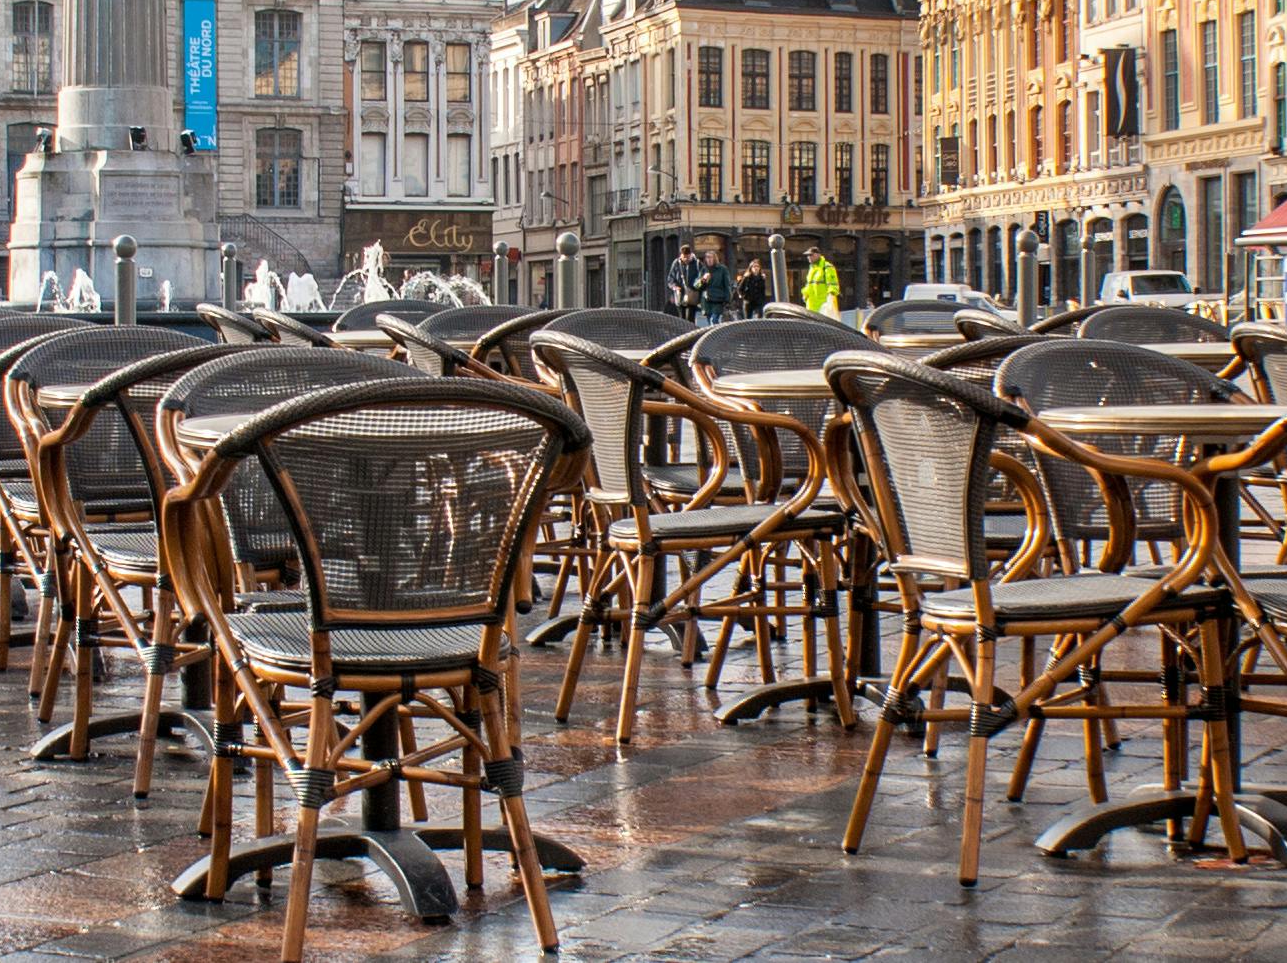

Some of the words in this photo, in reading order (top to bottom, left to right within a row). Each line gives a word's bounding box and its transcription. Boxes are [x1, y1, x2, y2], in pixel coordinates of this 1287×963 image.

[201, 19, 213, 57] NORD
[187, 36, 201, 95] THÉÂTRE
[201, 57, 213, 78] DU
[816, 202, 850, 227] Café
